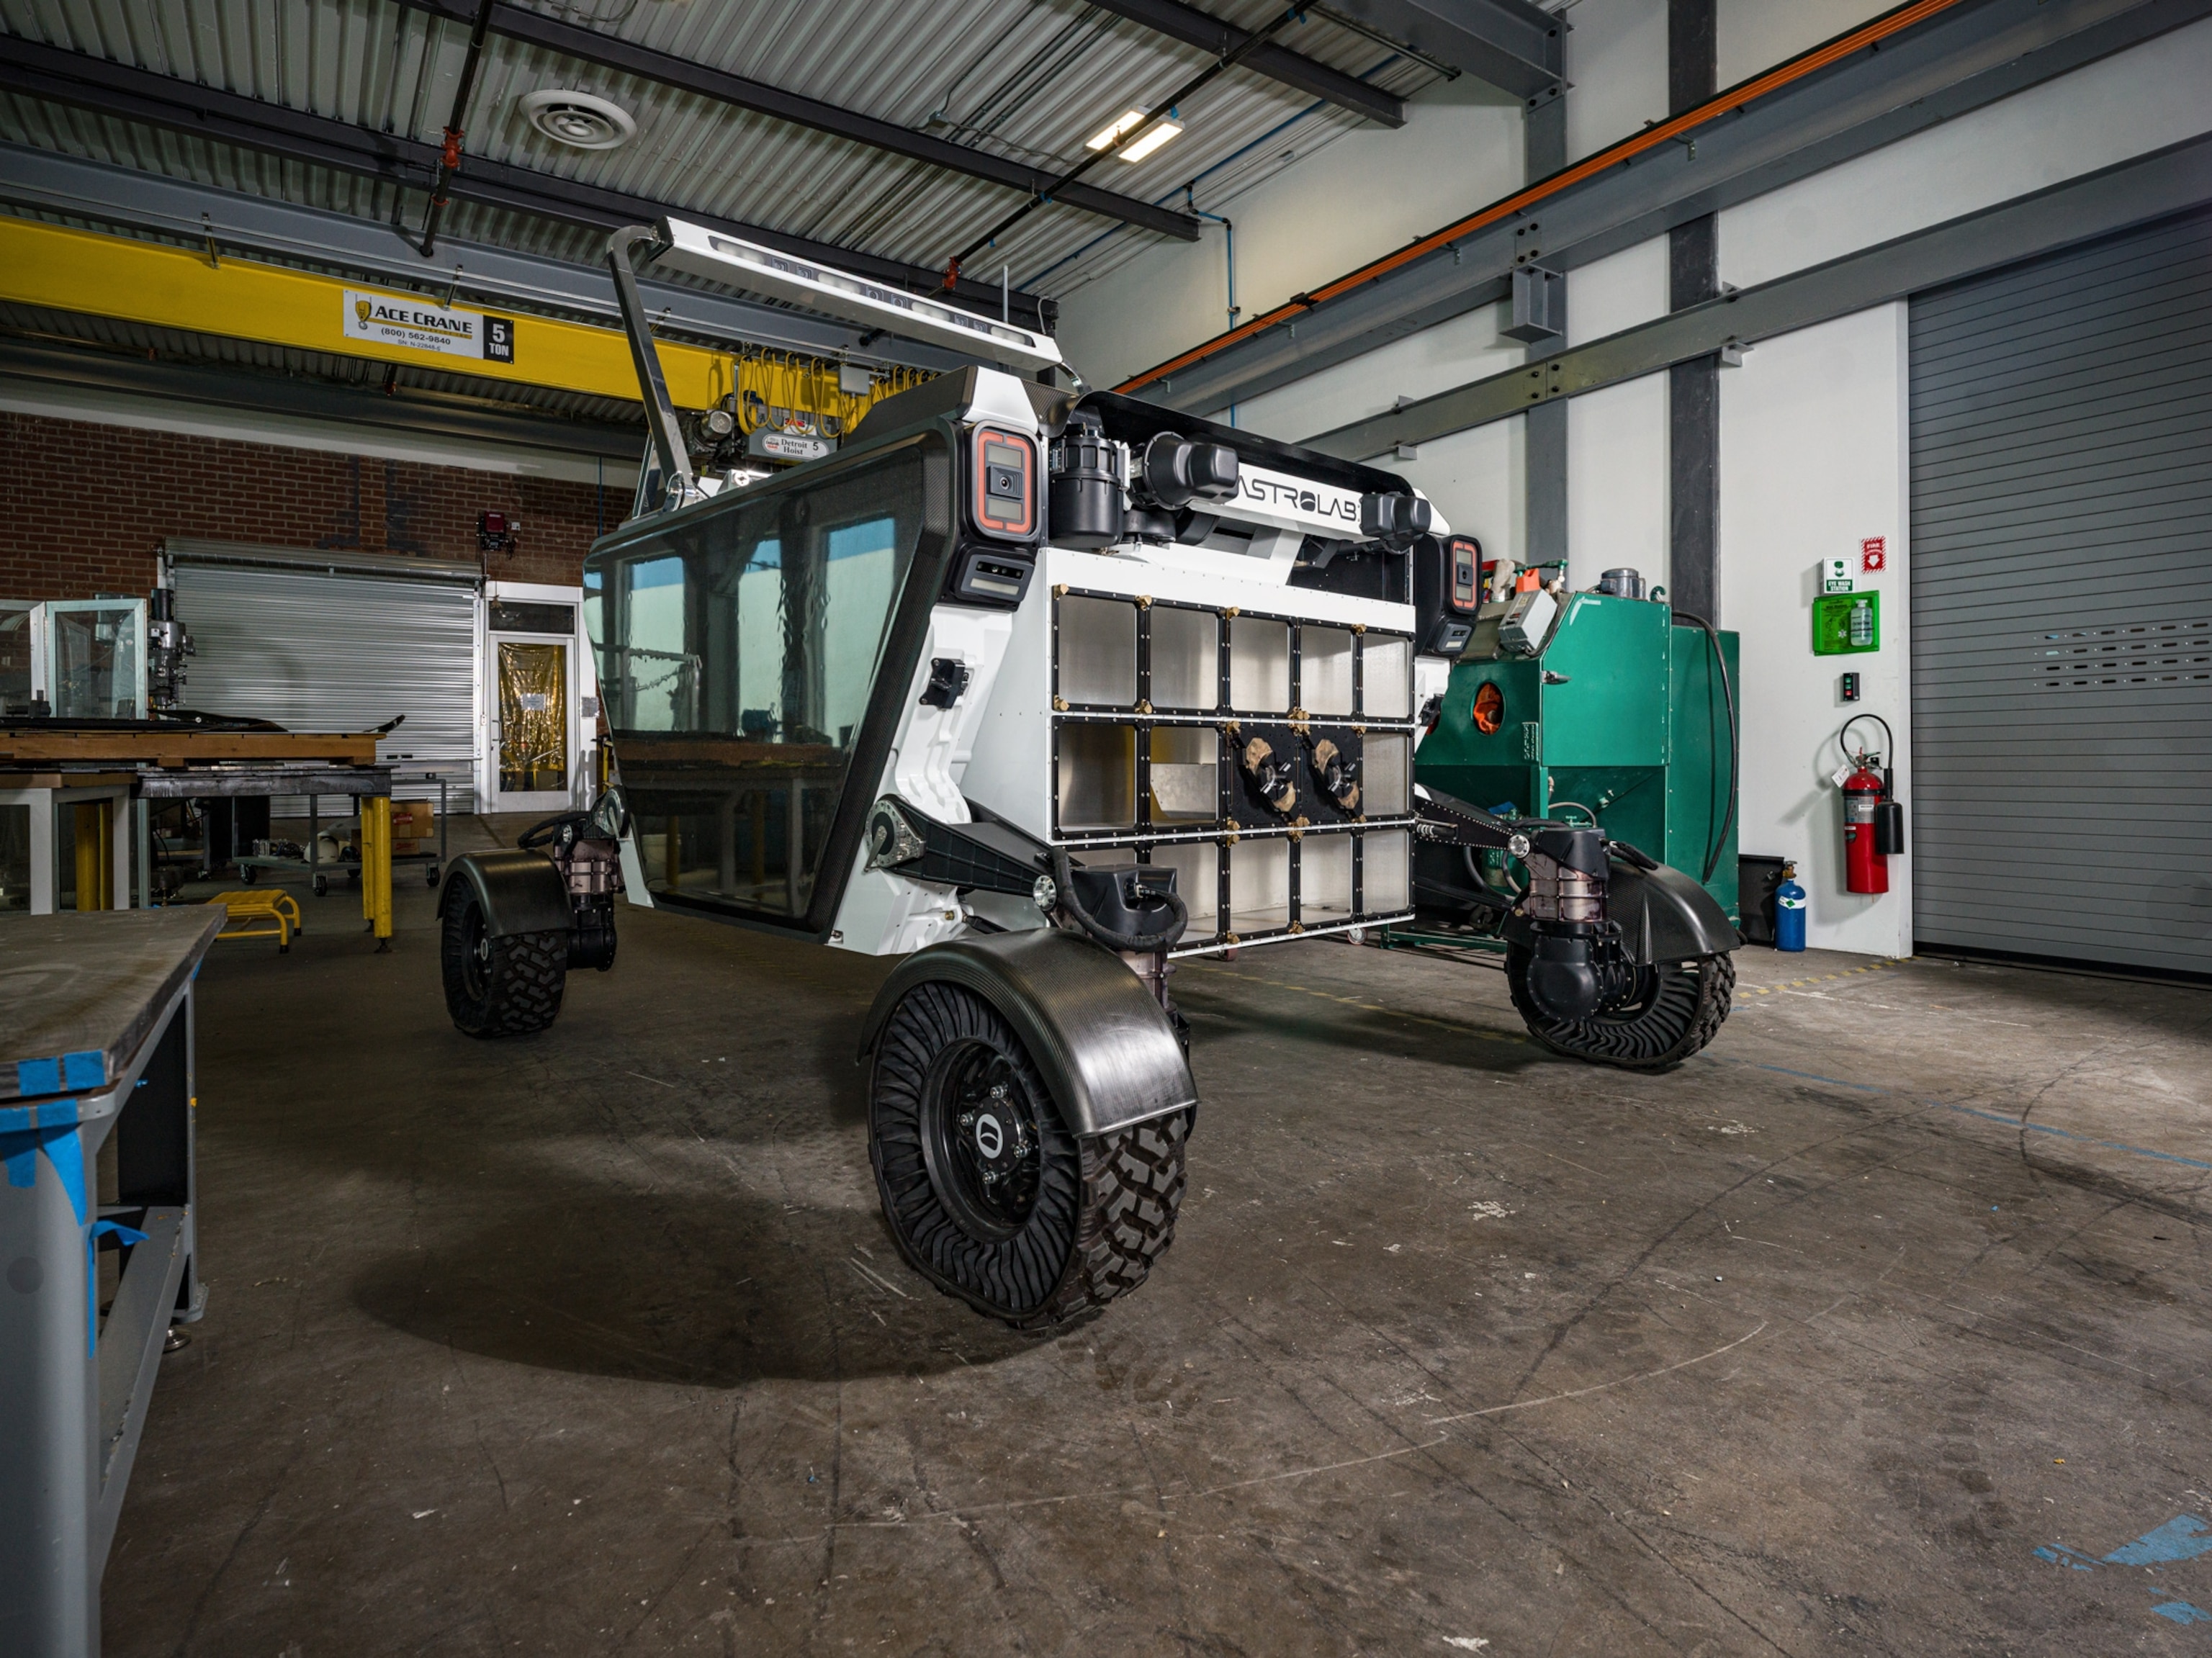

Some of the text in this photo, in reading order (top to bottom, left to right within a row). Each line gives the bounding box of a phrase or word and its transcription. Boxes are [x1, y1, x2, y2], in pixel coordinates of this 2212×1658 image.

[374, 305, 472, 333] ACE CRANE
[381, 327, 451, 345] (800) 562-9840
[419, 326, 453, 336] SERVICE
[493, 324, 505, 343] 5
[488, 342, 509, 357] TON
[781, 438, 807, 449] Detroit
[783, 446, 803, 455] Hoist
[812, 441, 819, 451] 5
[1238, 475, 1357, 522] ASTROLAB
